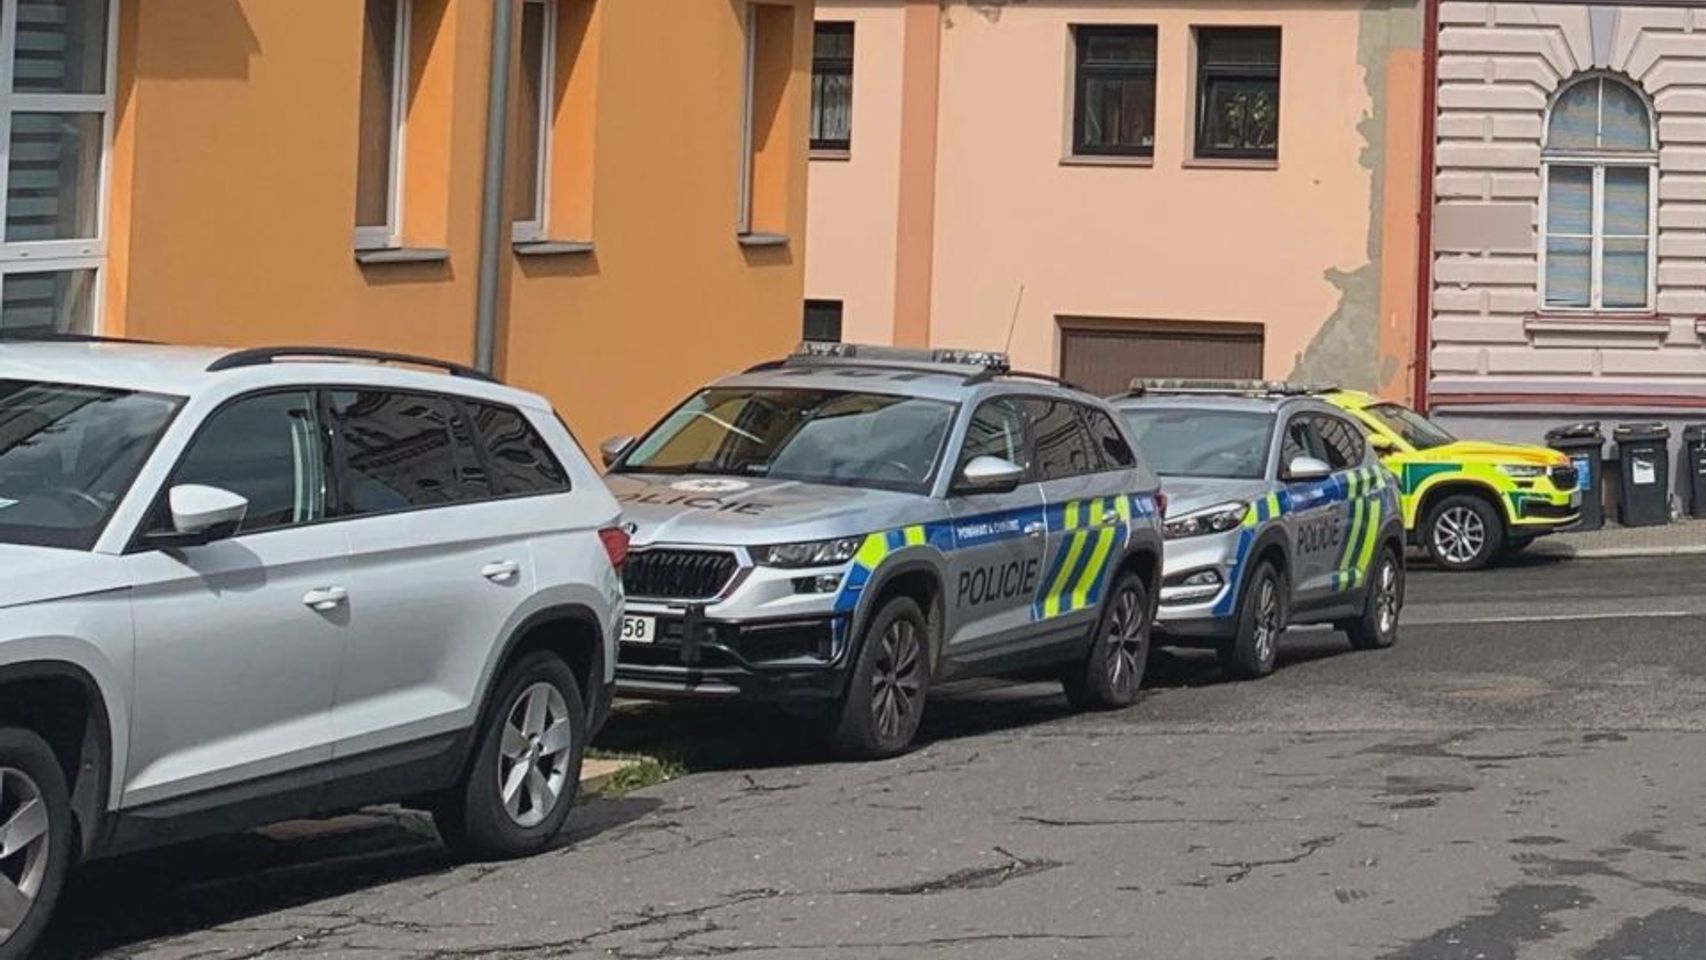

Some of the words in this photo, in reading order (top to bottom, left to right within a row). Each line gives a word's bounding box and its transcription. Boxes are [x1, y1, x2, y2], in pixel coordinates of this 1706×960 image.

[614, 493, 773, 516] OLICIE
[1296, 517, 1340, 556] POLICIE
[956, 558, 1039, 608] POLICIE
[624, 618, 646, 638] 58
